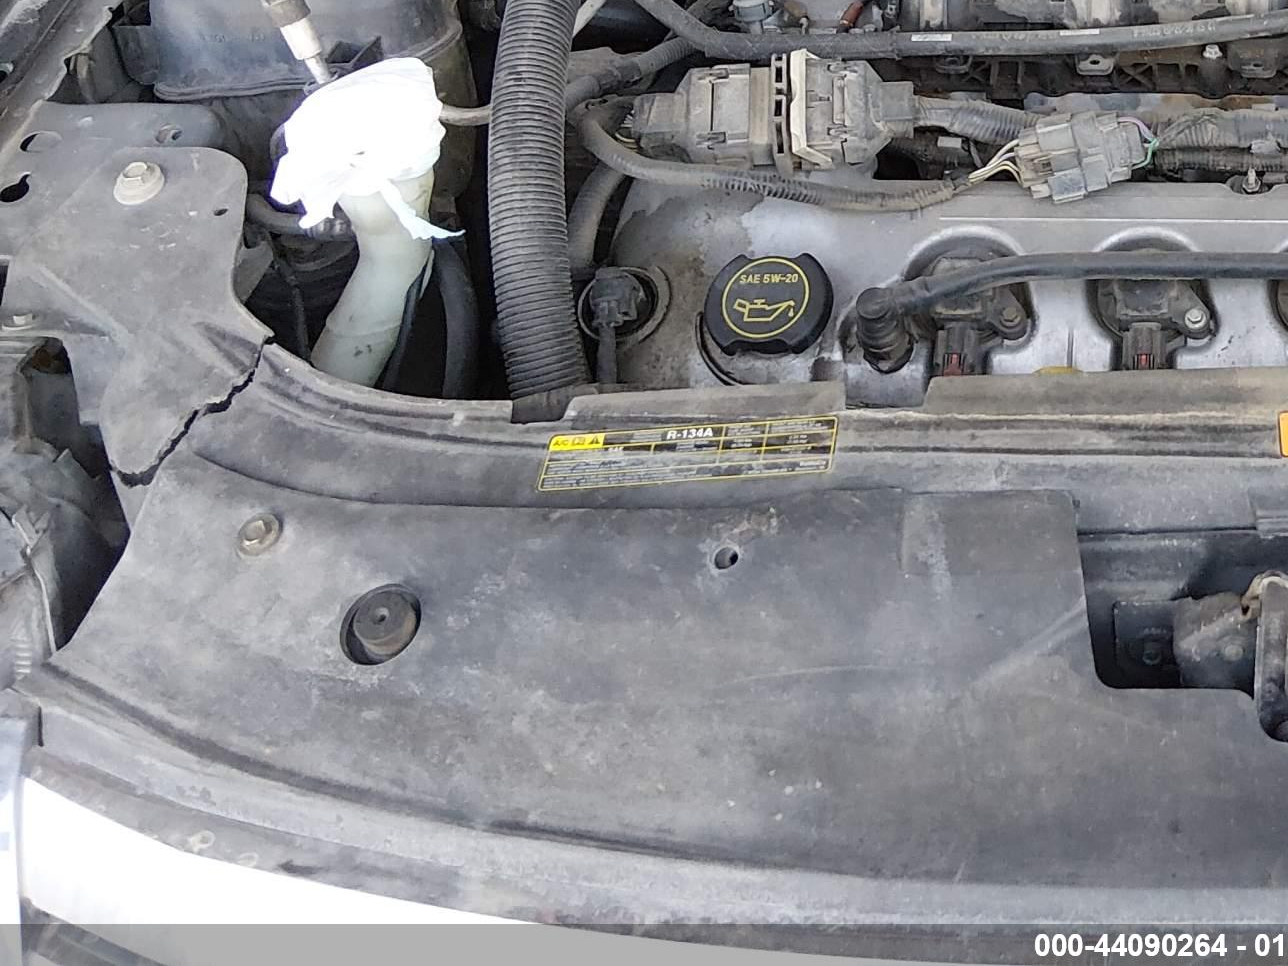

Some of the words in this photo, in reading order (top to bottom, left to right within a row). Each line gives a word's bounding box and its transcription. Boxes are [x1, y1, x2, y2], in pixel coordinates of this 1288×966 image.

[740, 274, 760, 284] SAE
[763, 273, 799, 284] 5W-20
[666, 427, 713, 440] R-134A
